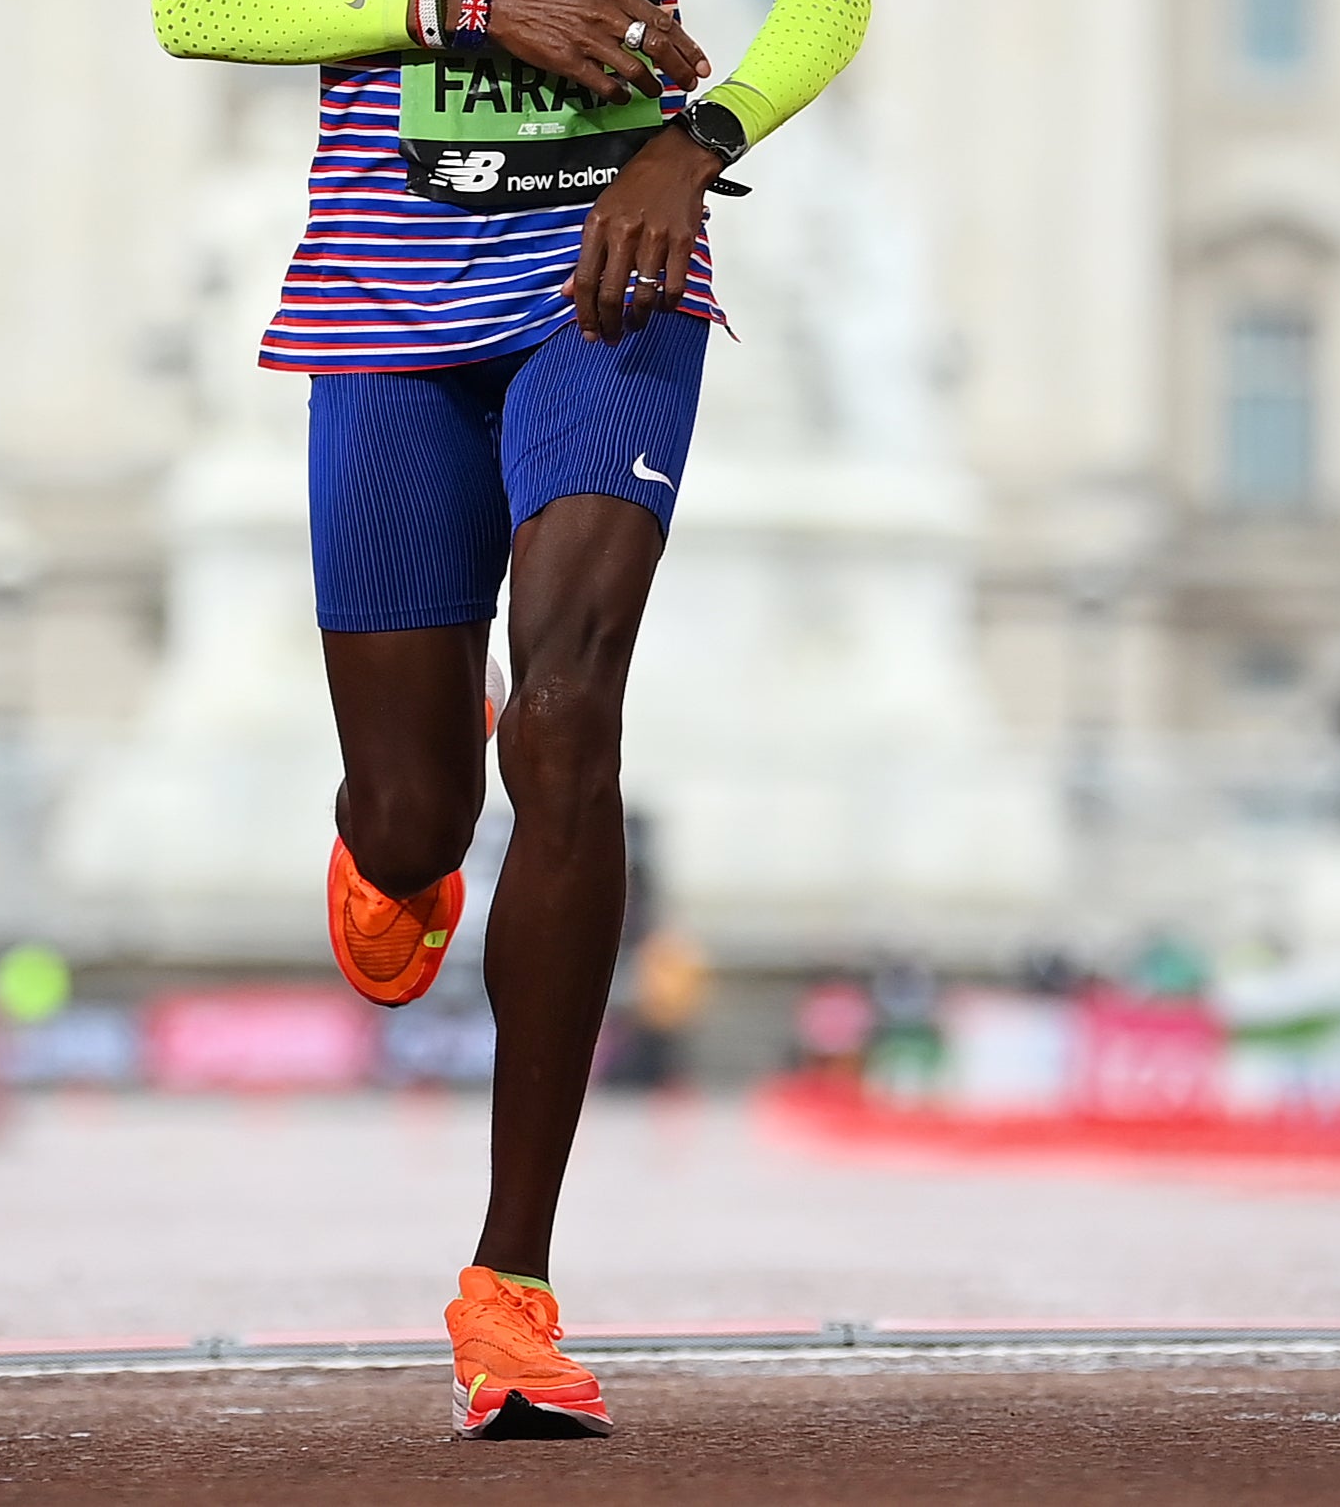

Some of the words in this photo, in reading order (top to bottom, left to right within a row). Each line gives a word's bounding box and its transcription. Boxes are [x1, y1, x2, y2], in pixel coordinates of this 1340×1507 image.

[434, 56, 629, 113] FARA
[507, 174, 554, 192] new
[558, 165, 619, 189] balan
